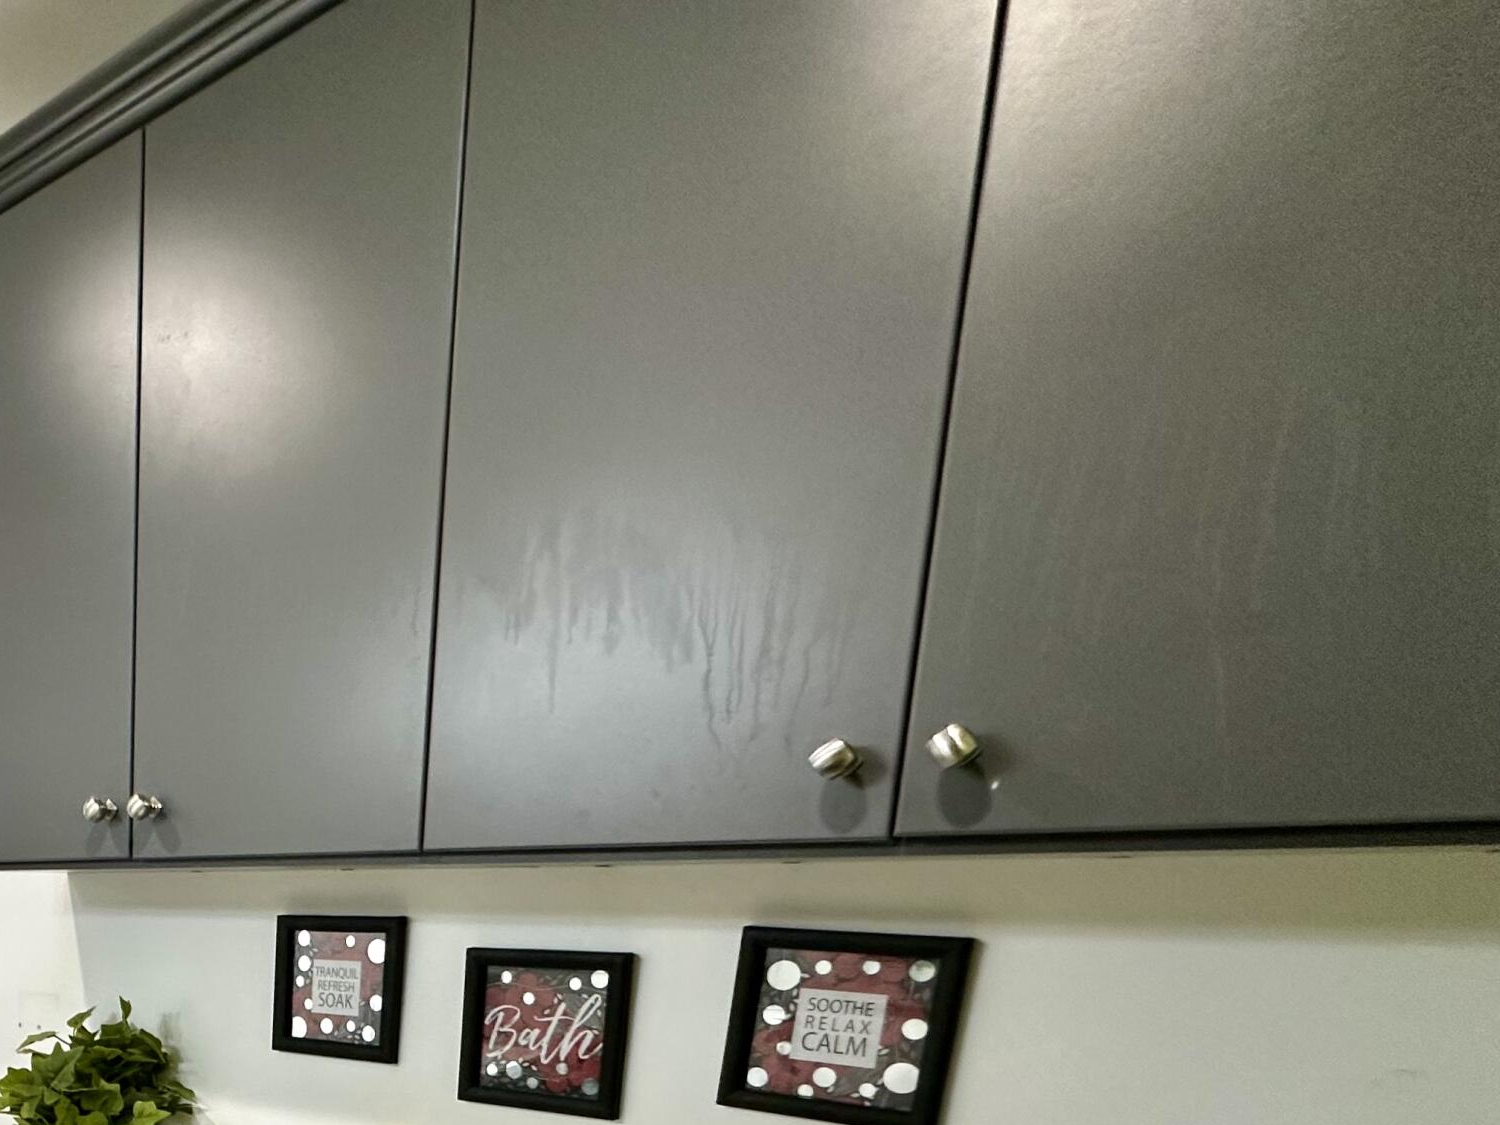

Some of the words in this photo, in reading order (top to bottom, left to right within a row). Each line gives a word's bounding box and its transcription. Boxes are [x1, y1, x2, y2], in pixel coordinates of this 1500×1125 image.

[315, 966, 358, 980] TRANQUIL
[317, 979, 355, 993] REFRESH
[318, 992, 353, 1009] SOAK
[807, 996, 875, 1017] SOOTHE
[484, 994, 603, 1064] Bath
[804, 1014, 872, 1035] RELAX
[801, 1031, 867, 1058] CALM
